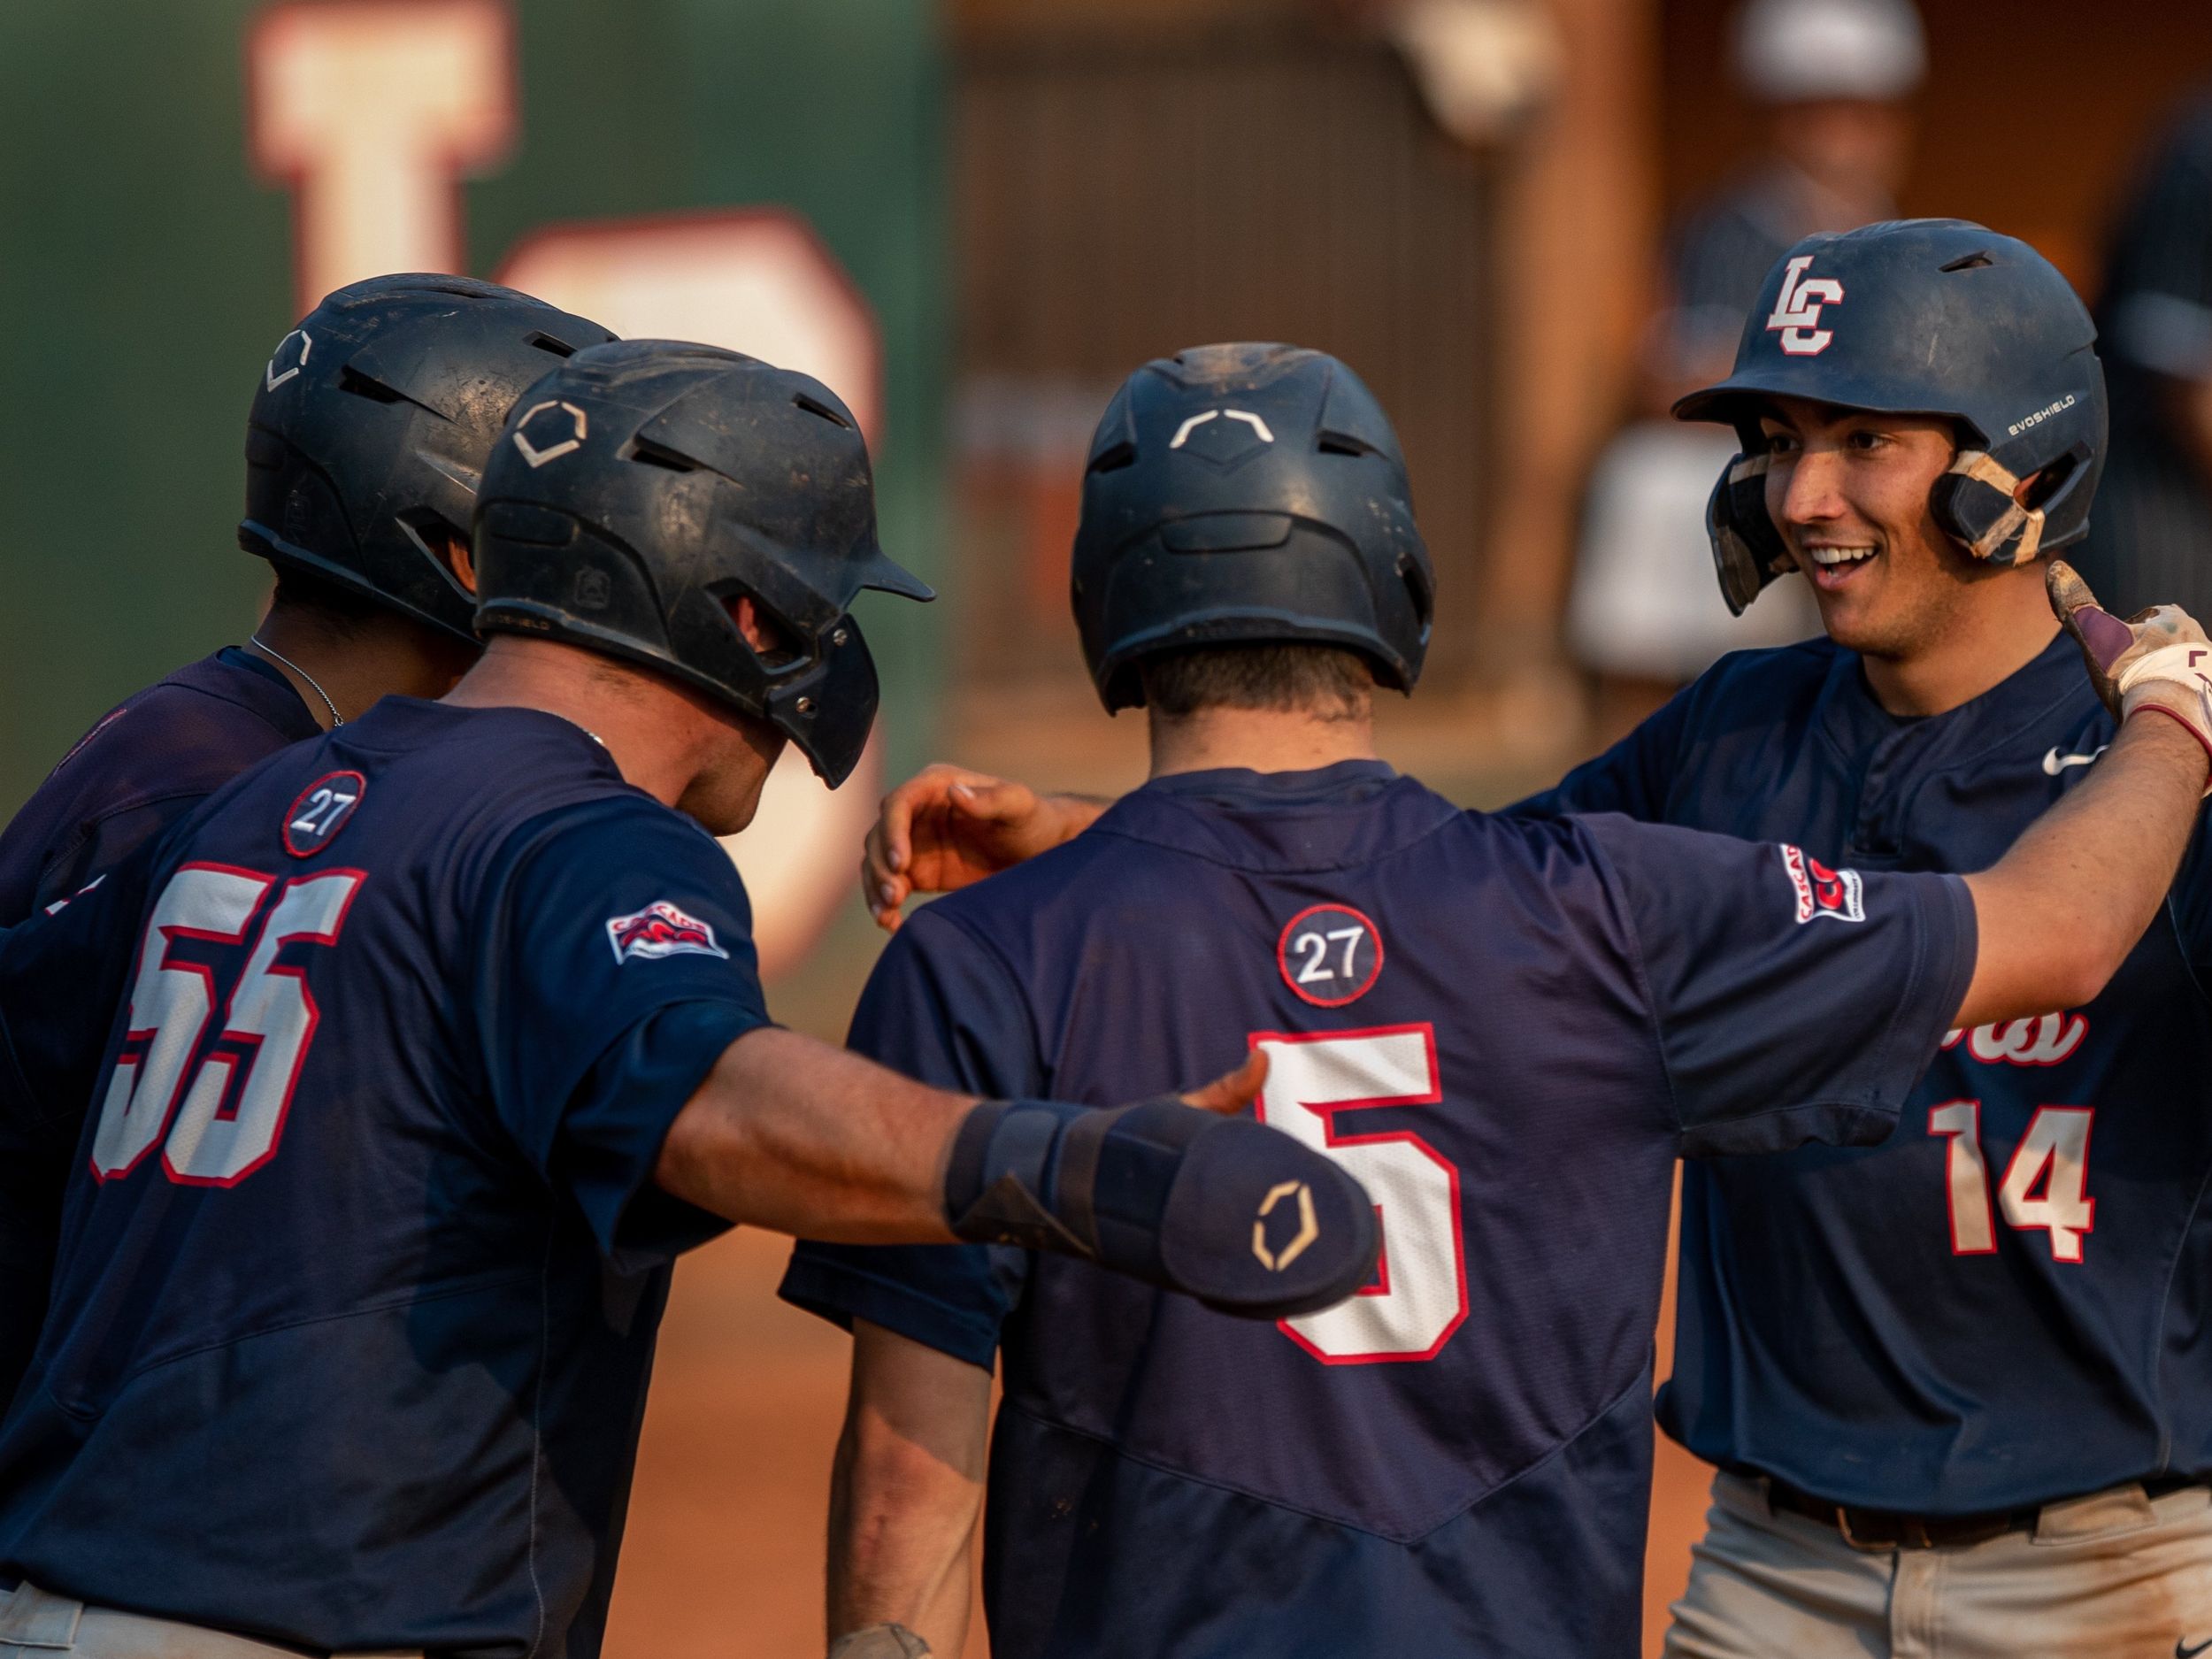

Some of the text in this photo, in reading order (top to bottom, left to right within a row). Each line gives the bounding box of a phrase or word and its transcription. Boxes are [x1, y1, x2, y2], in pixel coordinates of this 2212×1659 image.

[1766, 255, 1845, 356] LC
[2008, 395, 2076, 436] EVOSHIELD
[290, 788, 356, 836] 27
[1294, 926, 1364, 984] 27
[89, 860, 369, 1189] 55
[1248, 1021, 1469, 1365] 5
[1927, 1097, 2095, 1263] 14
